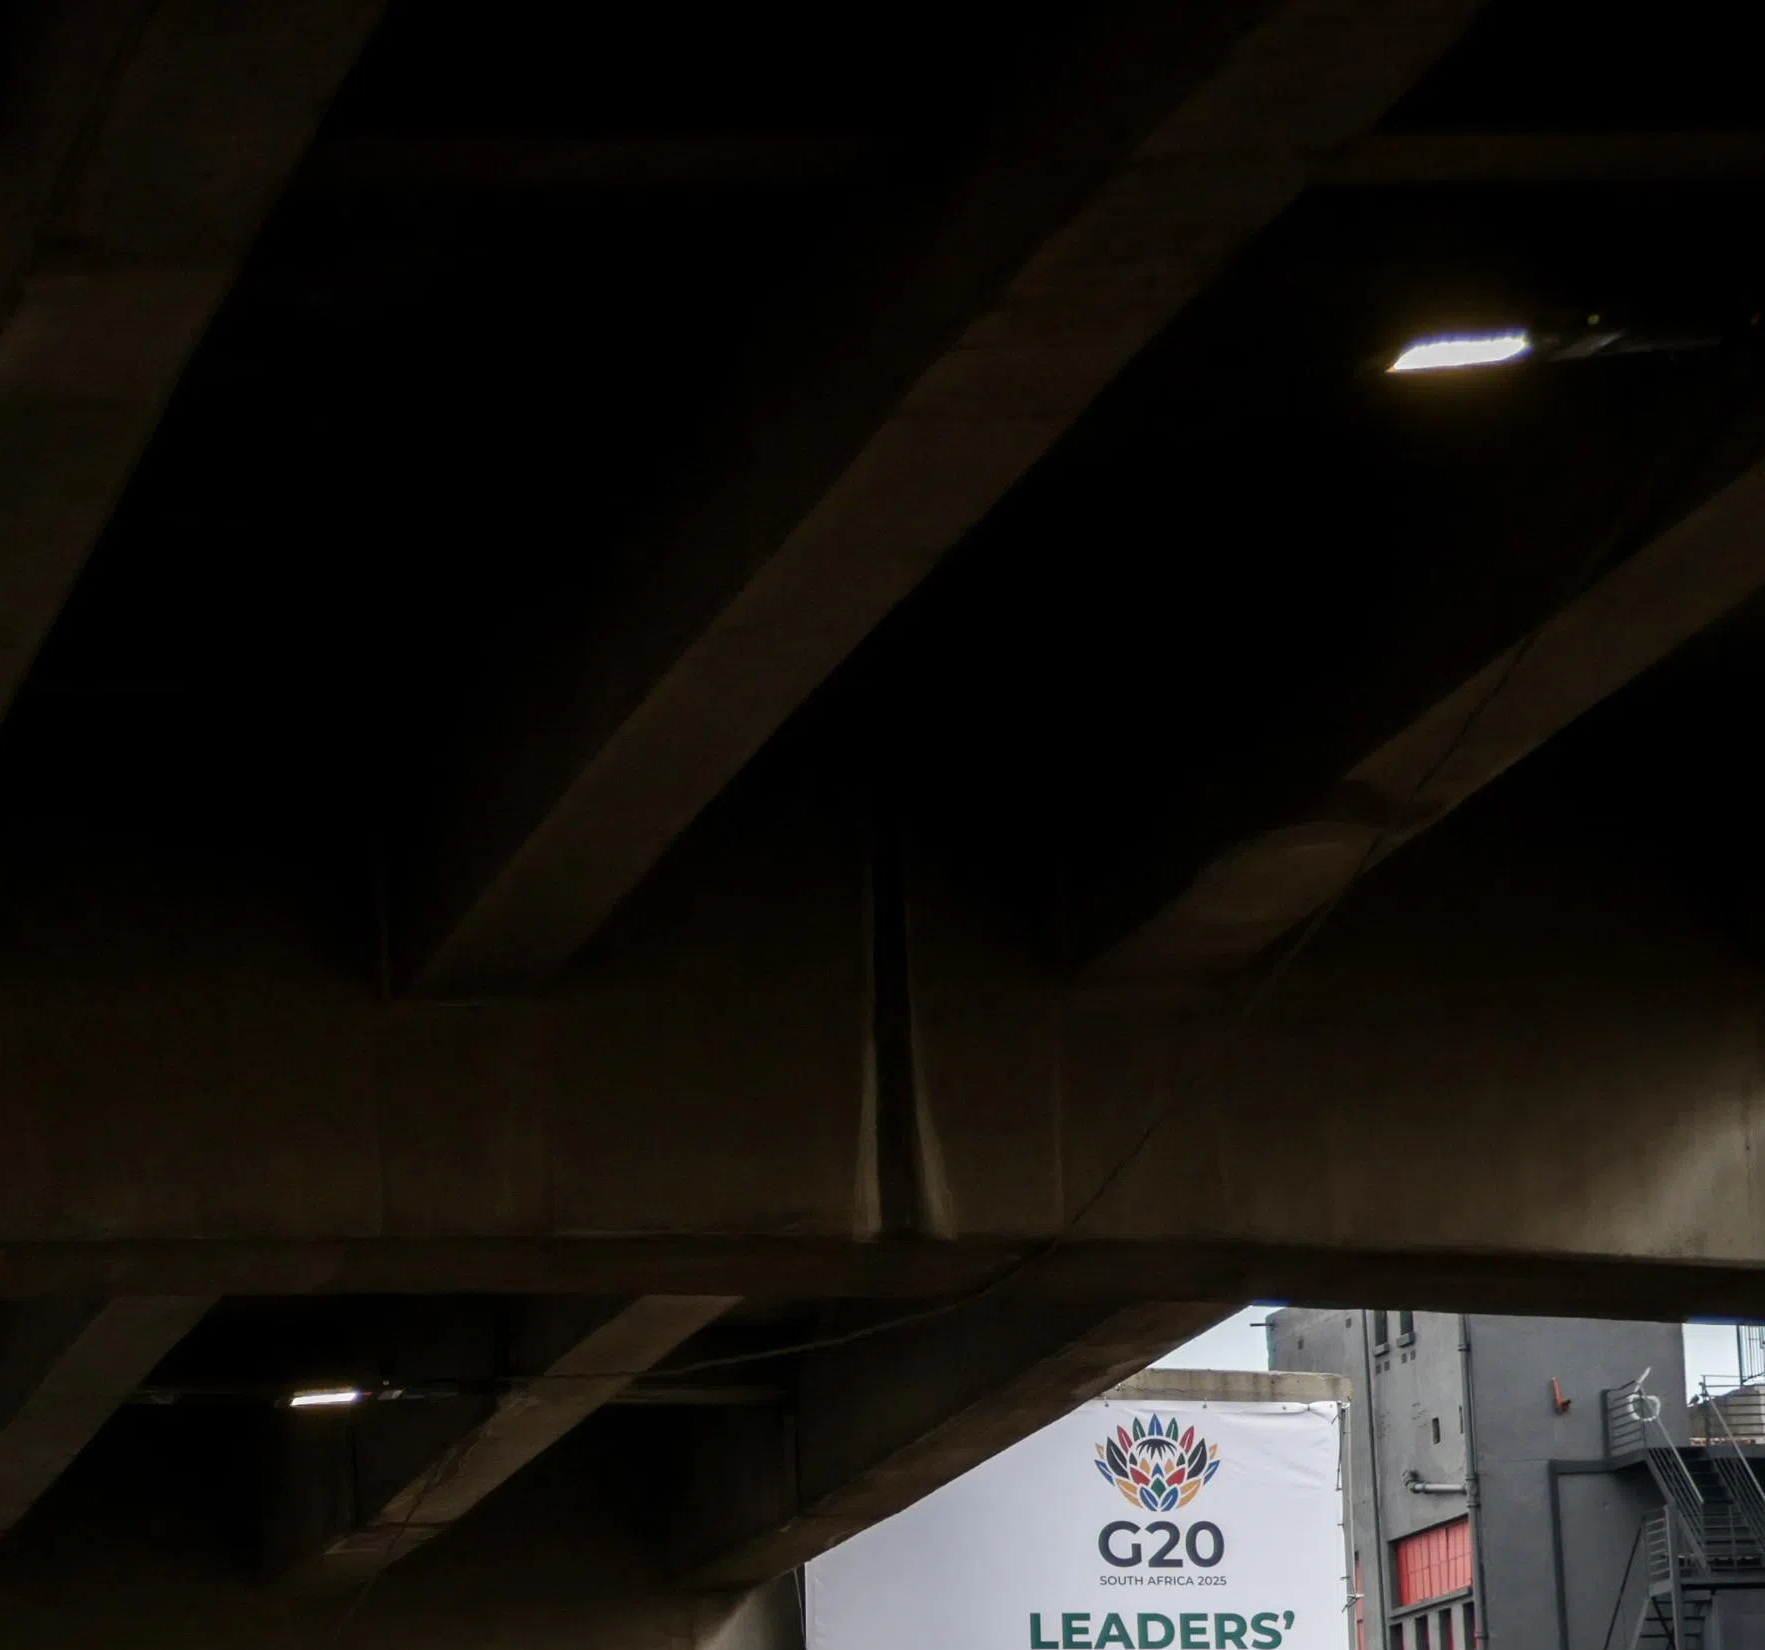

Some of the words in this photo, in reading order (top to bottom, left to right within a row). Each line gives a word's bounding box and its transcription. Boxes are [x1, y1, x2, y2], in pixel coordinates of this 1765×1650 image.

[1098, 1520, 1225, 1568] G20
[1099, 1575, 1144, 1586] SOUTH
[1147, 1575, 1195, 1586] AFRICA
[1198, 1575, 1227, 1586] 2025
[1030, 1610, 1295, 1650] LEADERS’
